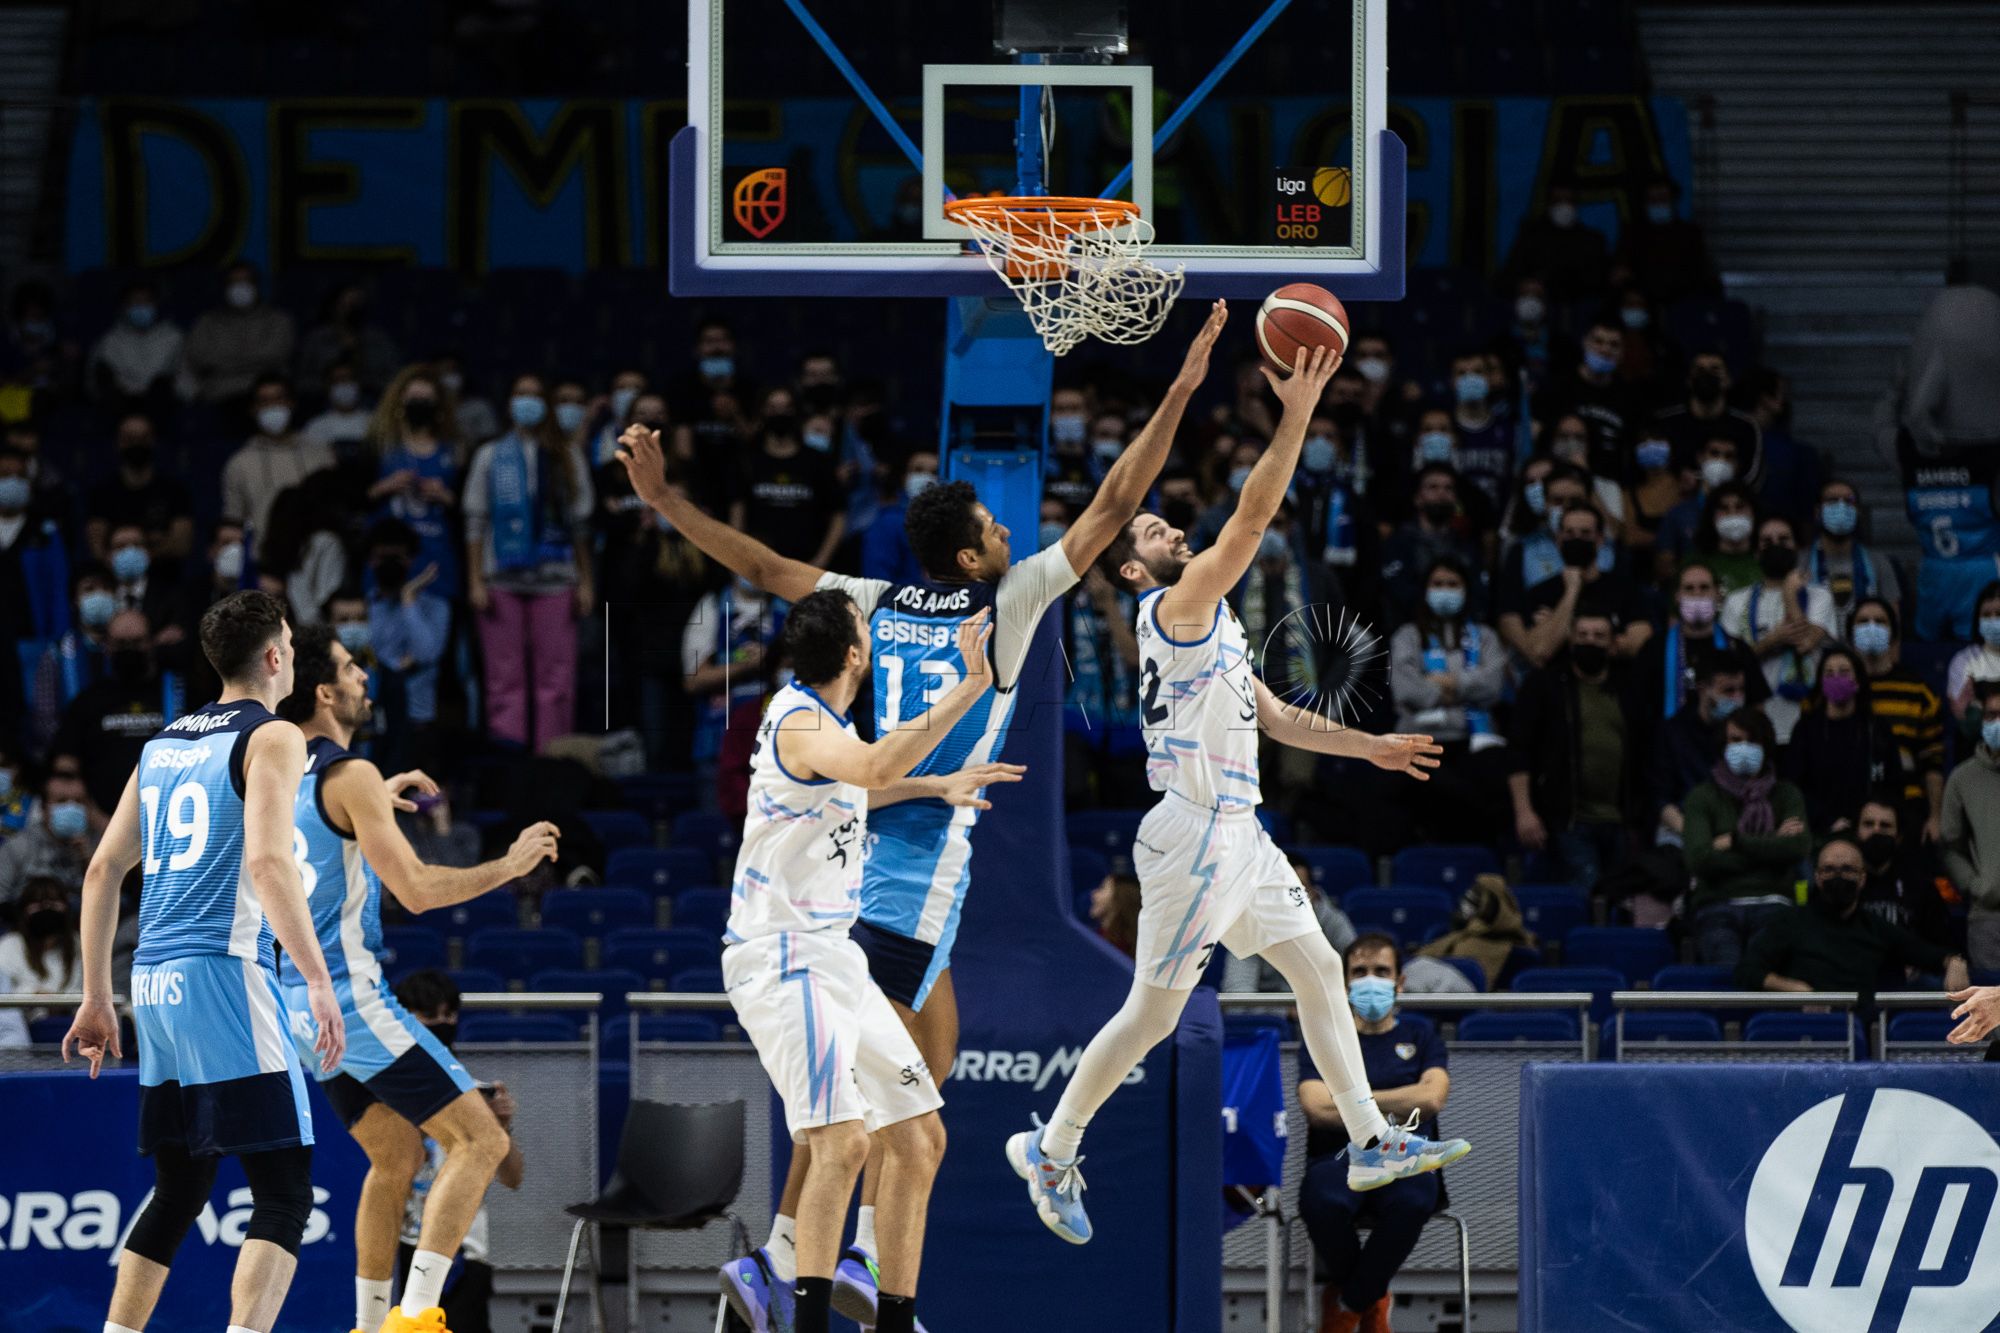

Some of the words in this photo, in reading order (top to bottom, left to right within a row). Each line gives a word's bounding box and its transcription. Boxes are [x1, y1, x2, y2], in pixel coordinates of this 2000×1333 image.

[1276, 176, 1306, 195] Liga
[1276, 203, 1321, 222] LEB
[1275, 224, 1319, 240] ORO
[141, 781, 210, 876] 19
[1779, 1085, 1998, 1333] hp
